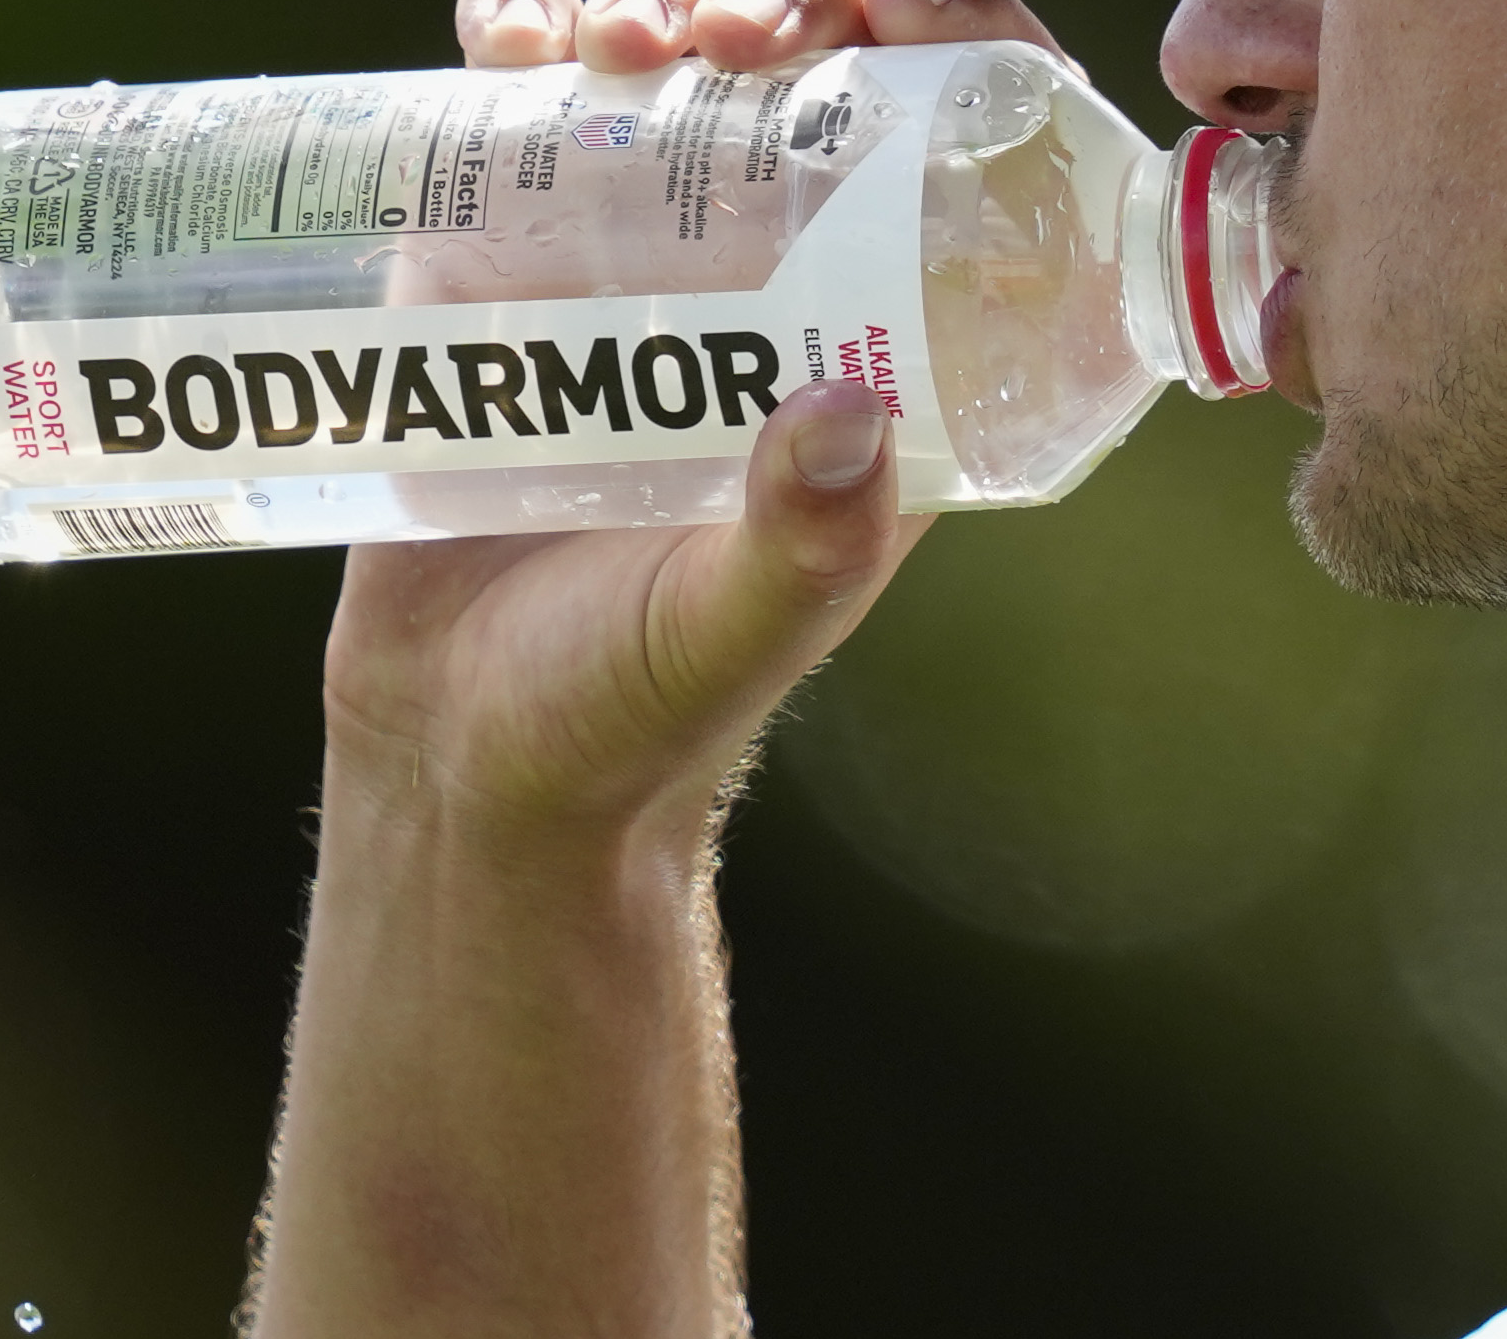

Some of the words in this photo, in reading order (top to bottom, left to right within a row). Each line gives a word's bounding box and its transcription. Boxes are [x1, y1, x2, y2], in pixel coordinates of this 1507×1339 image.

[775, 81, 797, 114] WIDE
[609, 115, 635, 145] USA
[688, 136, 701, 148] for
[123, 146, 138, 172] WEST
[134, 147, 151, 175] Sports
[516, 133, 541, 189] SOCCER
[655, 131, 674, 162] better.
[745, 127, 766, 182] HYDRATION
[761, 119, 785, 181] MOUTH
[150, 167, 162, 177] PA
[177, 154, 188, 173] water
[203, 142, 228, 205] Bicarbonate,
[222, 145, 242, 186] Reverse
[304, 172, 319, 185] 0g
[366, 163, 376, 171] %
[536, 142, 560, 191] WATER
[666, 153, 684, 205] hydration.
[684, 151, 698, 176] taste
[698, 161, 711, 174] pH
[3, 179, 22, 195] CA
[105, 166, 121, 201] Soccer.
[112, 174, 131, 219] SENECA,
[169, 175, 184, 202] quality
[361, 173, 374, 195] Daily
[455, 160, 485, 228] Facts
[682, 179, 693, 198] and
[698, 178, 710, 192] 9+
[35, 197, 48, 219] THE
[47, 197, 62, 230] MADE
[125, 178, 142, 228] Nutrition,
[188, 184, 205, 236] Chloride
[216, 189, 232, 240] Osmosis
[240, 186, 253, 227] potassium.
[252, 193, 261, 216] added
[379, 208, 407, 227] 0
[429, 181, 445, 228] Bottle
[695, 195, 709, 240] alkaline
[32, 223, 44, 248] USA
[113, 223, 124, 239] NY
[167, 203, 182, 252] information
[200, 206, 216, 254] Calcium
[301, 212, 314, 232] 0%
[321, 211, 334, 231] 0%
[340, 210, 352, 230] 0%
[679, 211, 691, 240] wide
[46, 234, 58, 246] IN
[124, 232, 136, 256] LLC.
[111, 243, 122, 280] 14224
[838, 340, 865, 385] WAT
[865, 325, 904, 418] ALKALINE
[33, 361, 69, 455] SPORT
[79, 331, 782, 454] BODYARMOR
[2, 360, 39, 459] WATER
